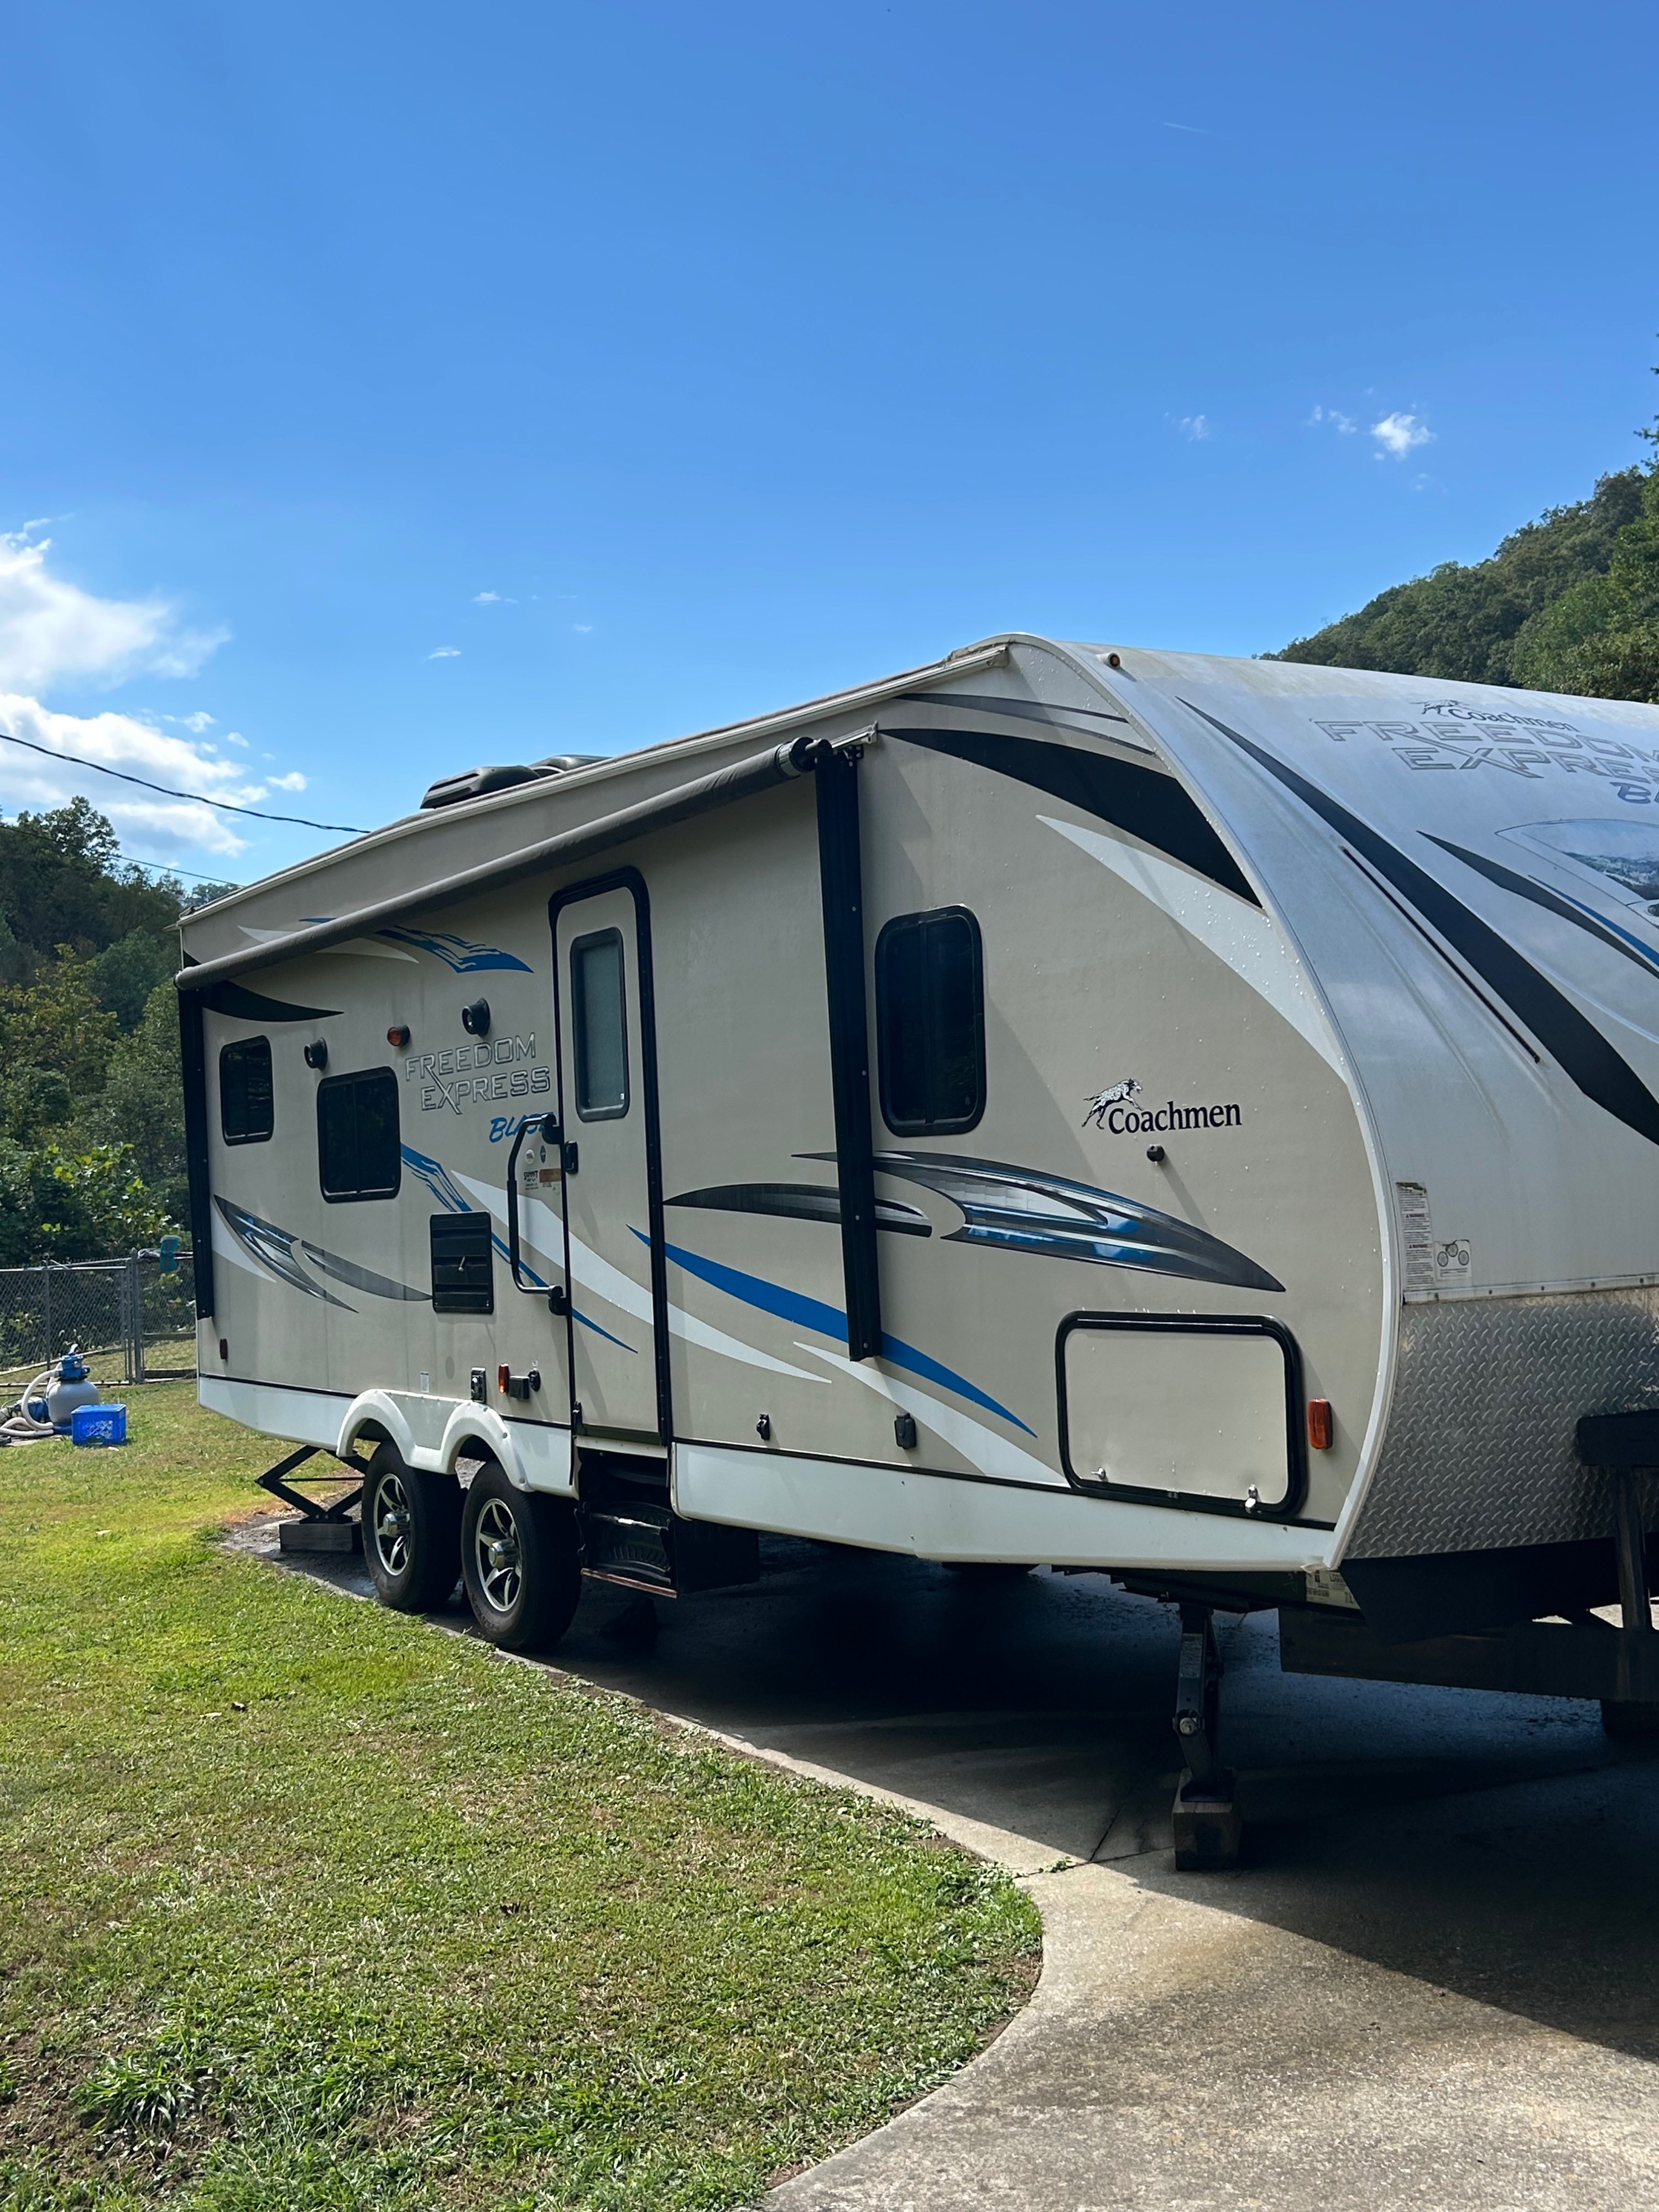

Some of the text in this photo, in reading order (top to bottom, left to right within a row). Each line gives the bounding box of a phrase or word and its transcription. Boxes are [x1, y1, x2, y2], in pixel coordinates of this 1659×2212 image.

[1448, 708, 1580, 732] Coachmen
[405, 1032, 536, 1082] FREEDOM
[421, 1066, 550, 1115] EXPRESS
[1108, 1100, 1243, 1134] Coachmen
